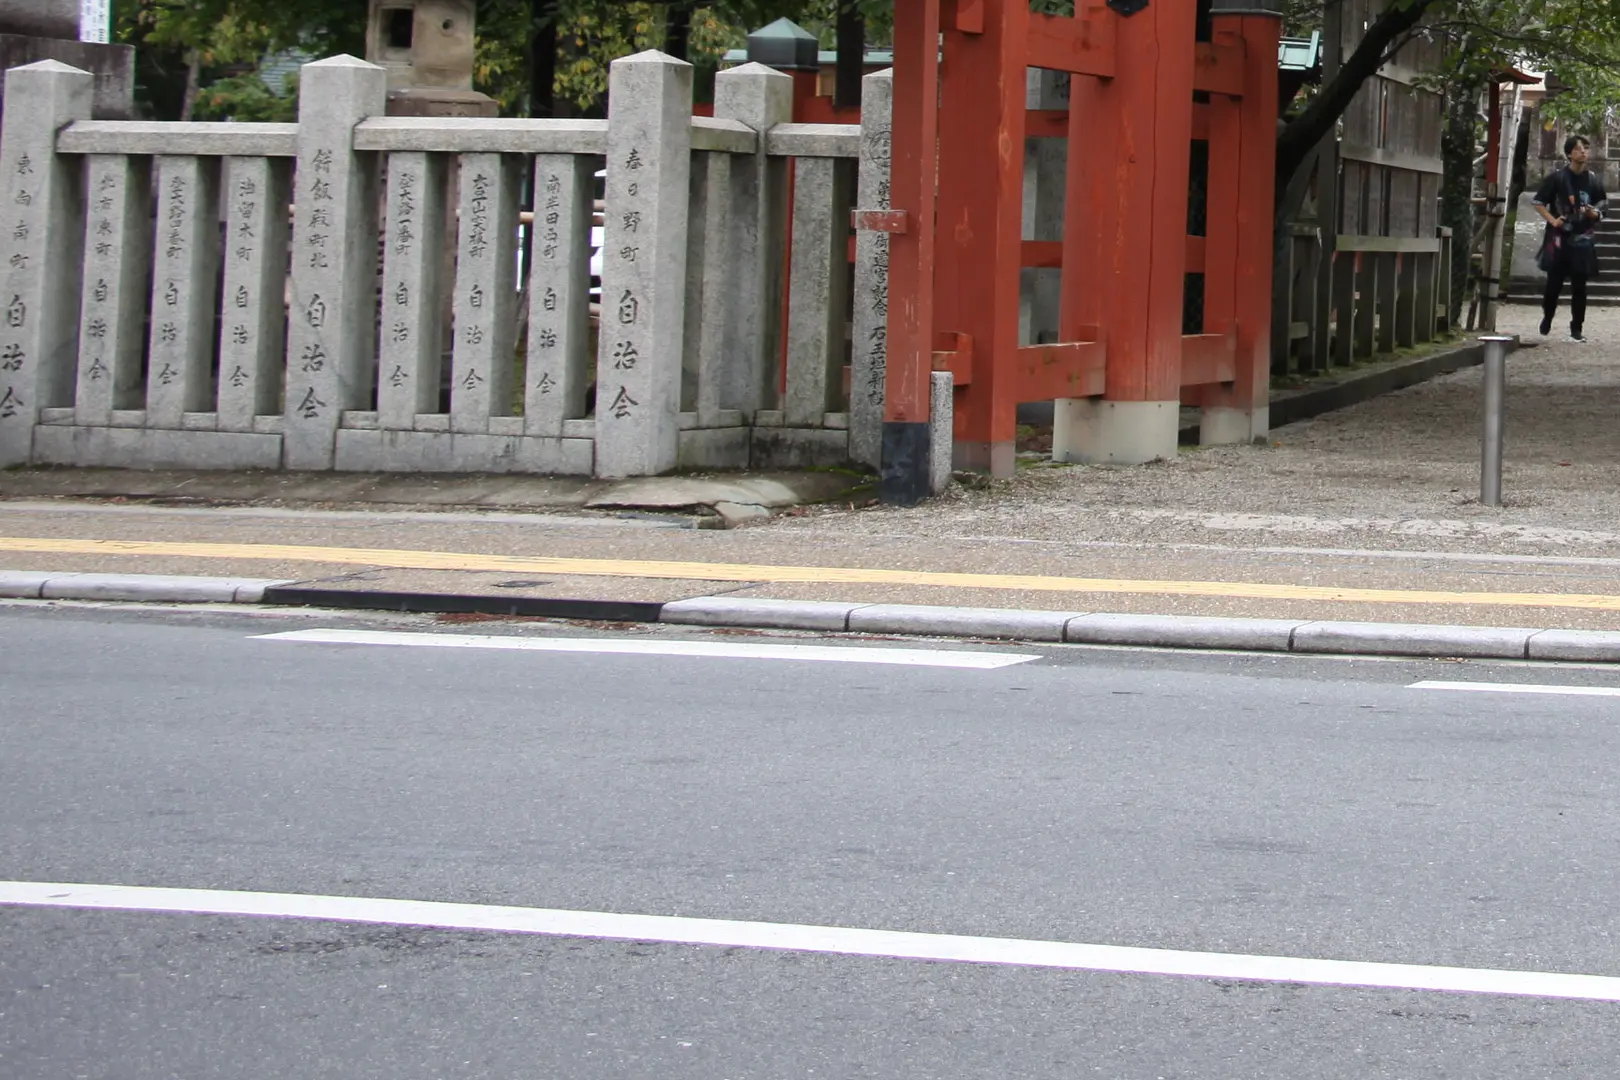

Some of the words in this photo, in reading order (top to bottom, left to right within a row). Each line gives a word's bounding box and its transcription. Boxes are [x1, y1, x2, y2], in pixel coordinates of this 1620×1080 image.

[609, 148, 643, 420] 春日野町自治会
